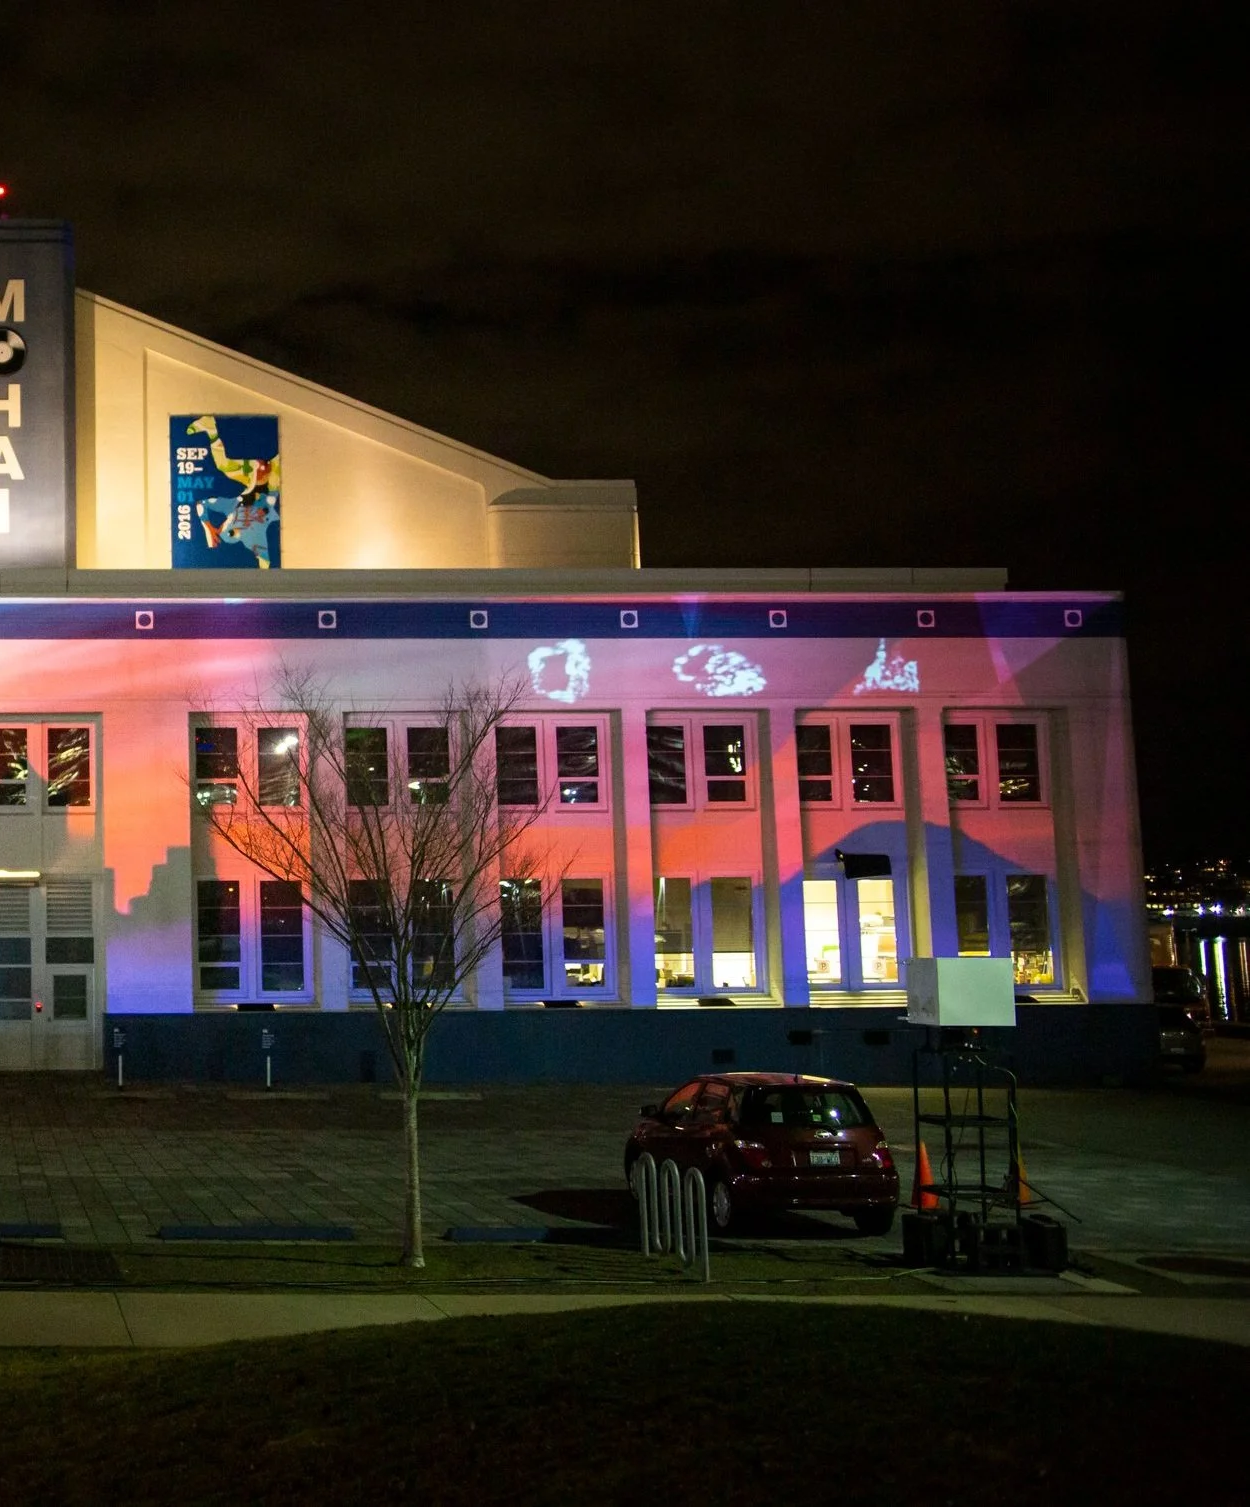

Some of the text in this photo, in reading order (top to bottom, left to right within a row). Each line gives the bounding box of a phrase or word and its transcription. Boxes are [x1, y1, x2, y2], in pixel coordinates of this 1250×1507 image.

[176, 447, 209, 460] SEP
[177, 476, 215, 489] MAY
[177, 490, 194, 503] 01
[178, 504, 192, 540] 2016
